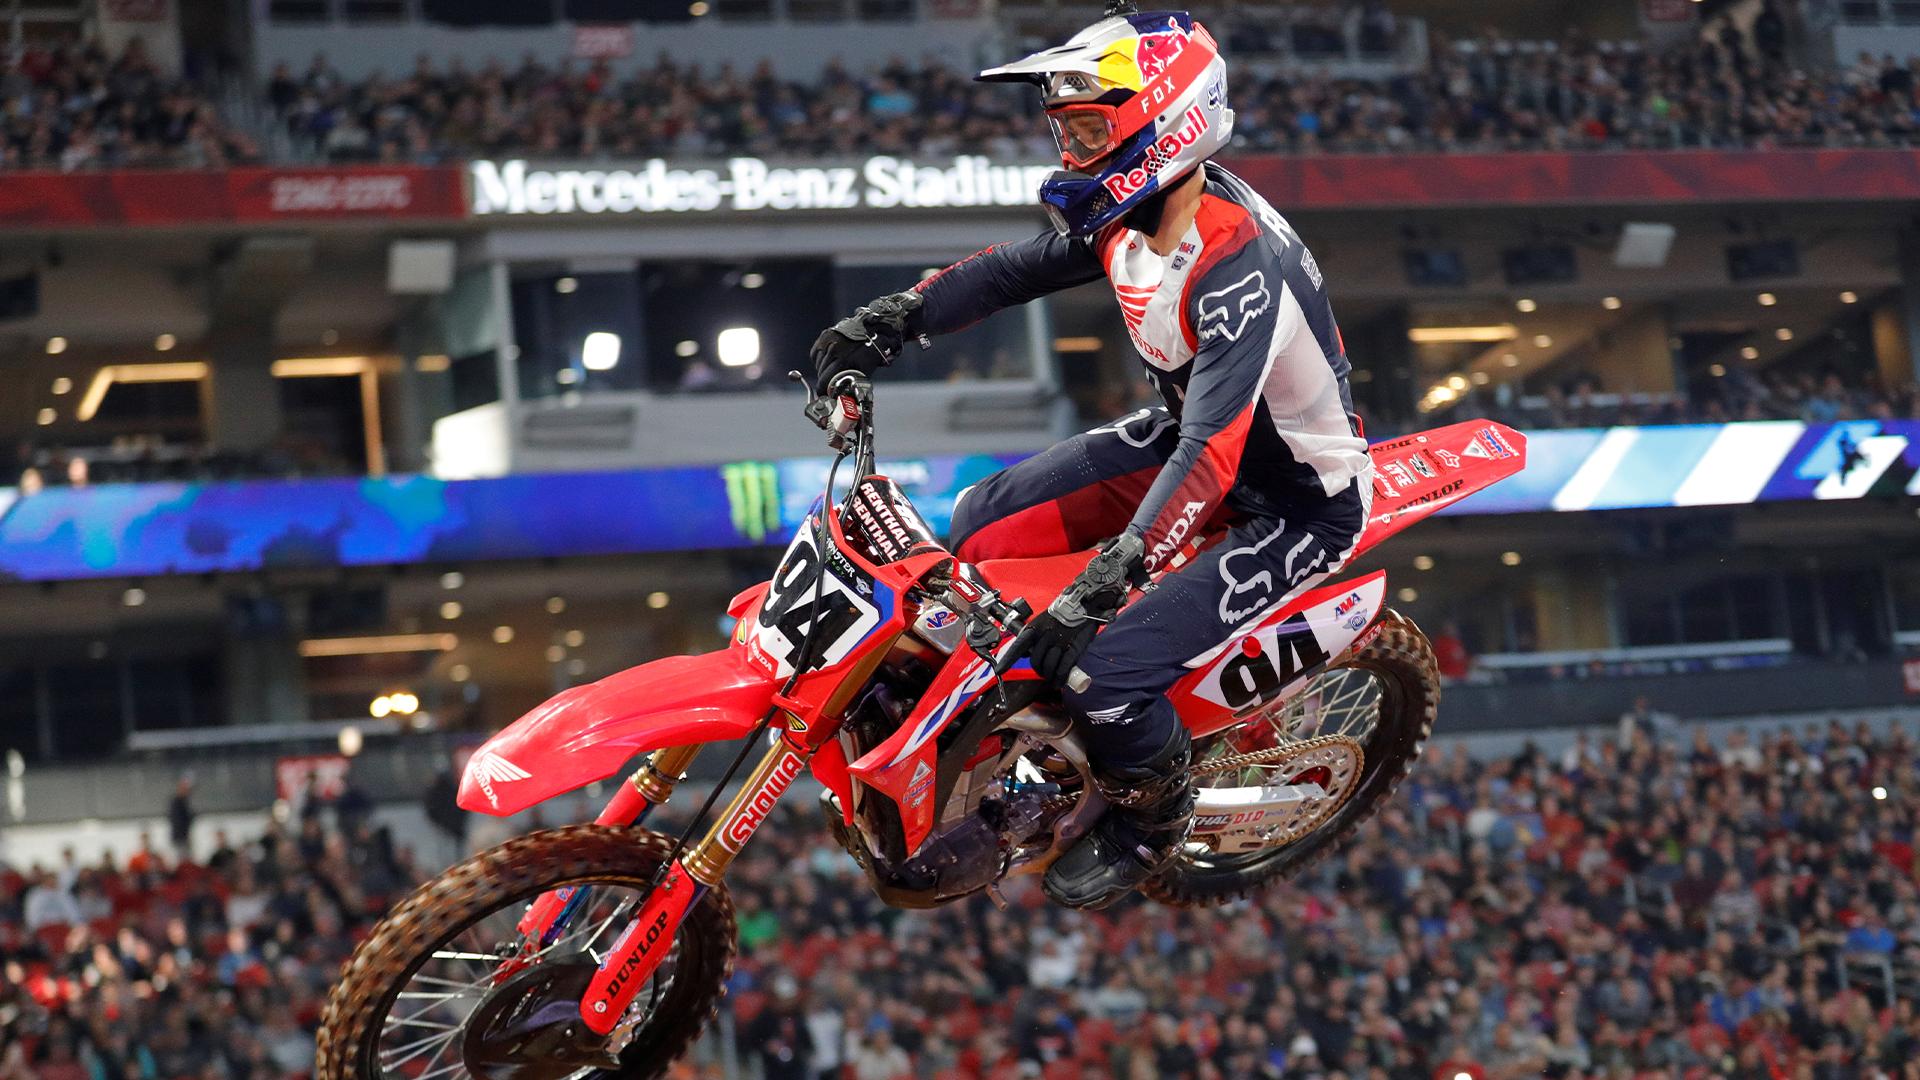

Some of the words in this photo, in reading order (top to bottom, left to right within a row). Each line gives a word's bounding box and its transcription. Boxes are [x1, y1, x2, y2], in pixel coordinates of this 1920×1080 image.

[1141, 76, 1176, 114] FOX
[471, 157, 859, 214] Mercedes-Benz
[852, 495, 898, 562] RENTHAL
[860, 482, 911, 549] RENTHAL
[1396, 478, 1464, 512] DUNLOP
[1143, 501, 1206, 573] ONDA
[759, 541, 863, 675] 94
[1334, 592, 1363, 619] AMA
[750, 641, 773, 672] HONDA
[1219, 611, 1331, 712] 94
[729, 754, 804, 843] SHOWA
[606, 910, 668, 999] DUNLOP
